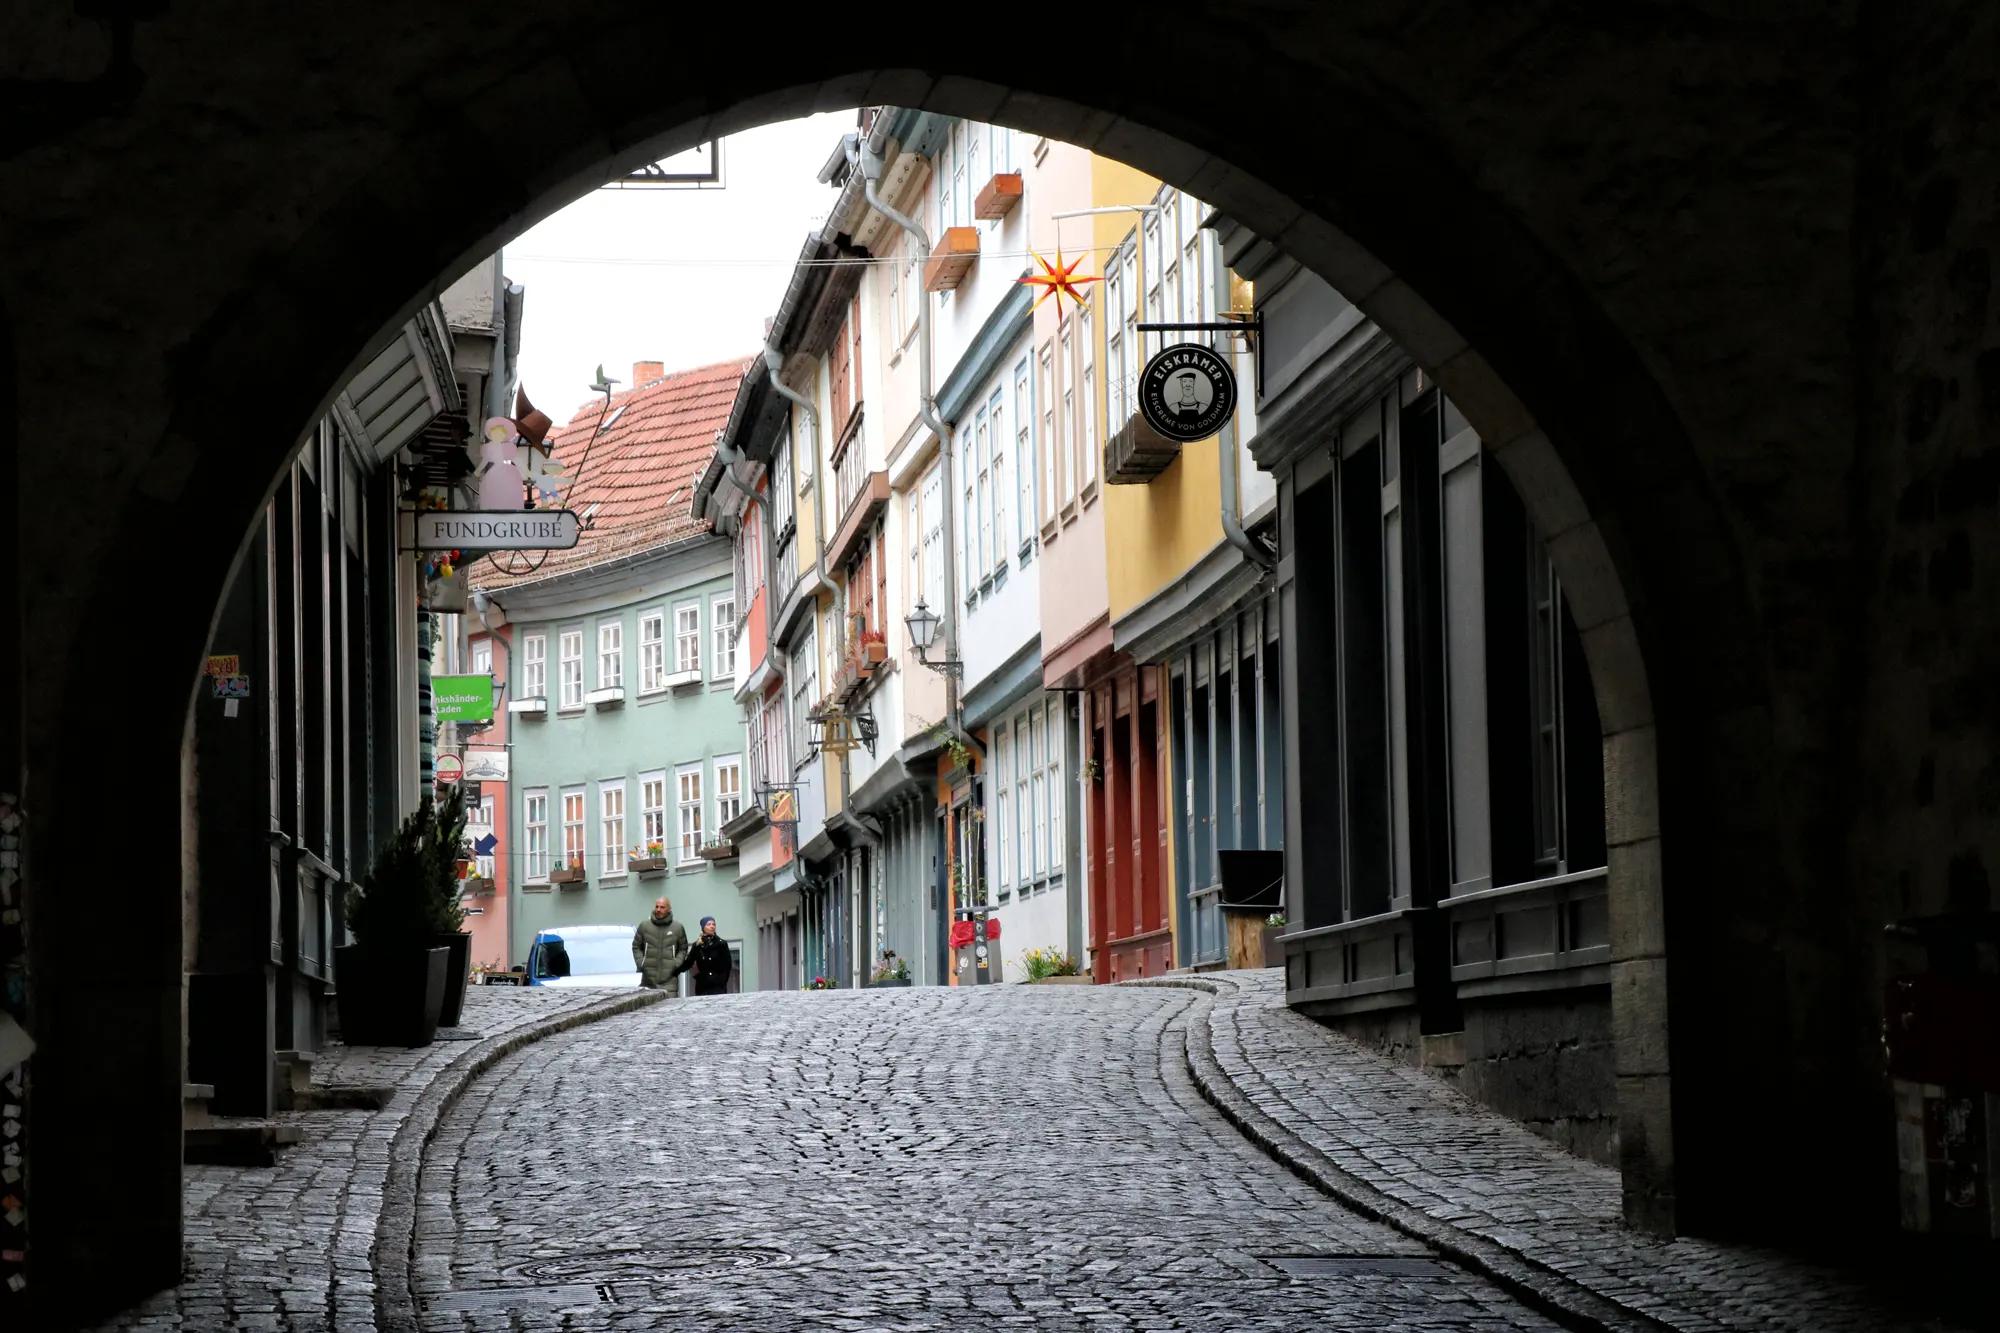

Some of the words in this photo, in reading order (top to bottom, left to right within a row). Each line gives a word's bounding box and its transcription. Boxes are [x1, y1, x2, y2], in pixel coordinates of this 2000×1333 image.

[1153, 352, 1223, 380] EISKRÄMER
[1151, 392, 1176, 428] EISCREME
[1178, 423, 1195, 431] VON
[1197, 392, 1226, 428] GOLDHELM
[434, 521, 563, 538] FUNDGRUBE
[436, 705, 461, 714] Laden
